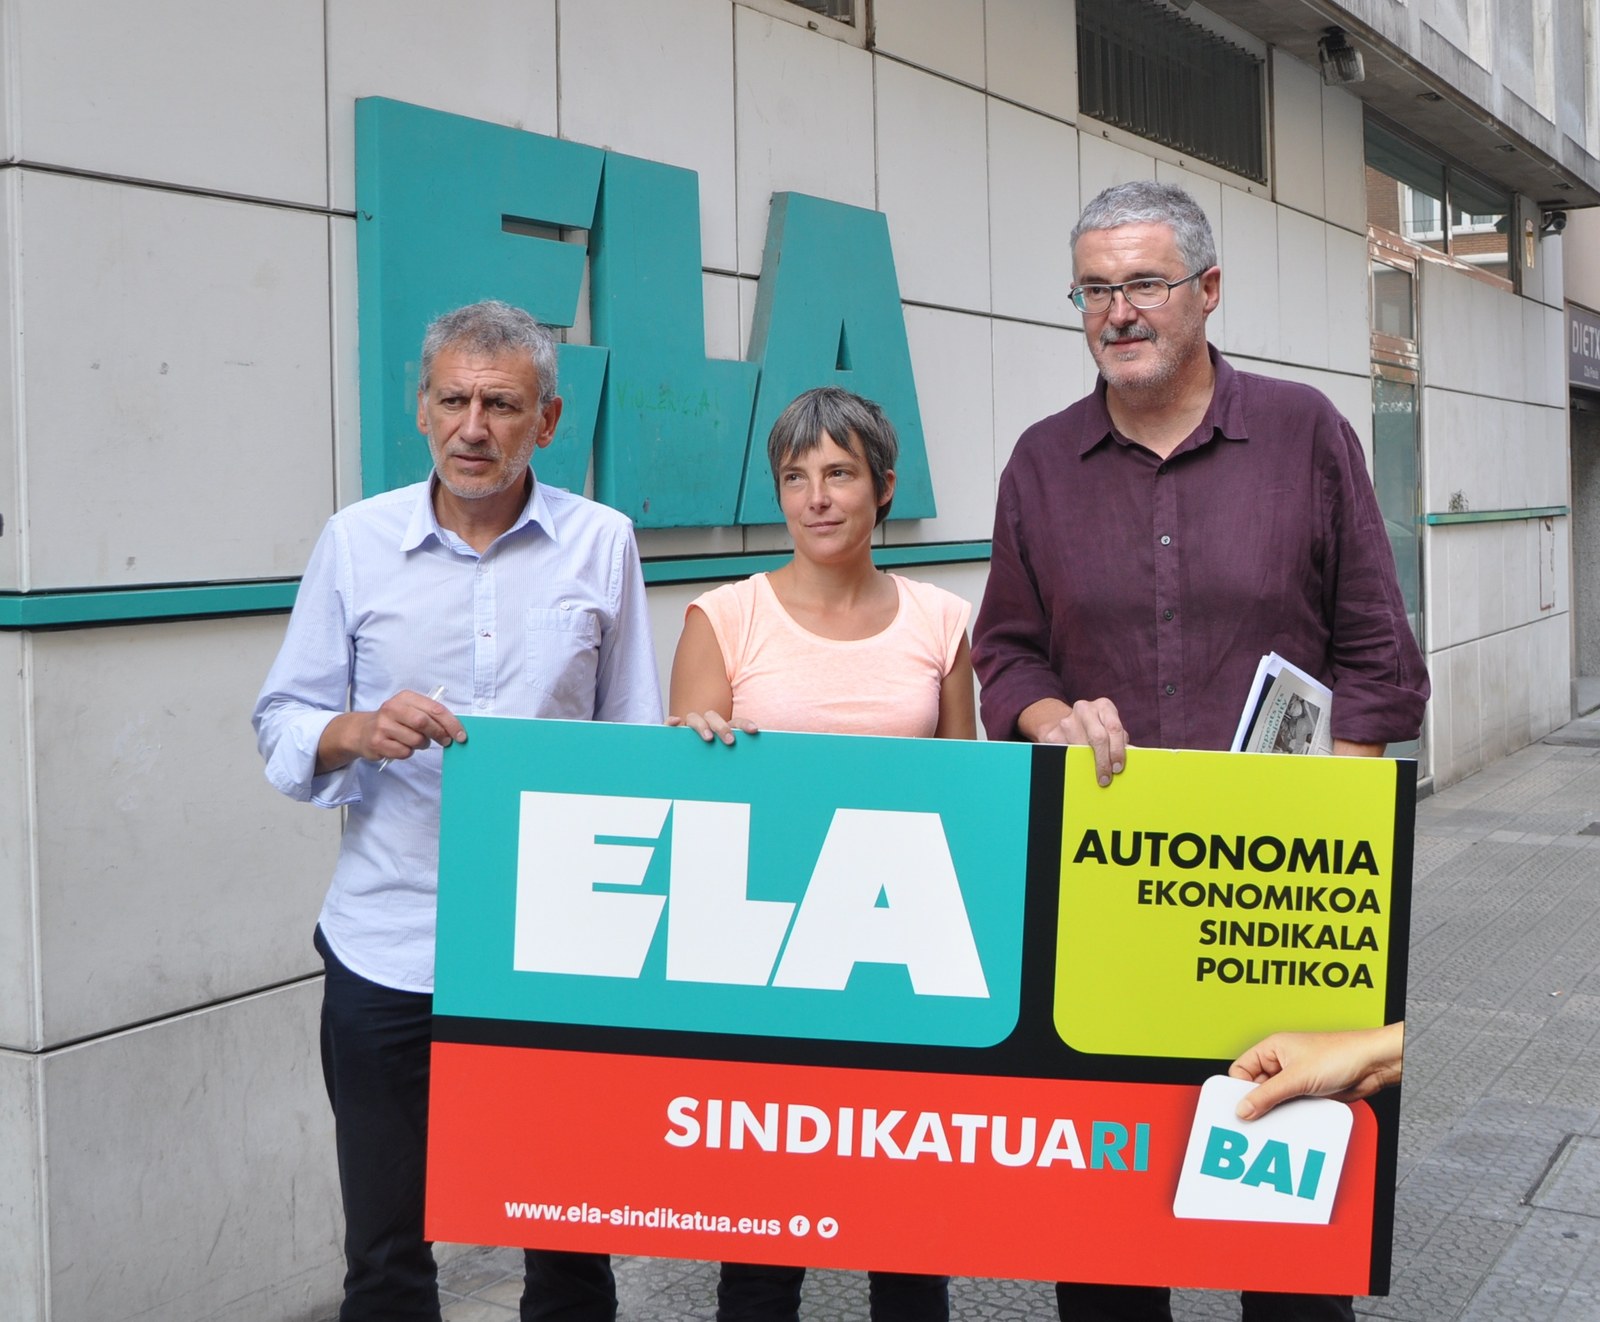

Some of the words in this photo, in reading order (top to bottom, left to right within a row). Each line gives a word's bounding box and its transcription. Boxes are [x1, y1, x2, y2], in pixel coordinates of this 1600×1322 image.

[356, 96, 936, 528] ELA
[1073, 829, 1380, 876] AUTONOMIA
[513, 791, 990, 998] ELA
[1137, 880, 1381, 914] EKONOMIKOA
[1199, 919, 1379, 952] SINDIKALA
[1196, 957, 1374, 989] POLITIKOA
[664, 1096, 1150, 1172] SINDIKATUARI
[1200, 1125, 1326, 1201] BAI
[505, 1201, 781, 1236] www.ela-sindikatua.eus
